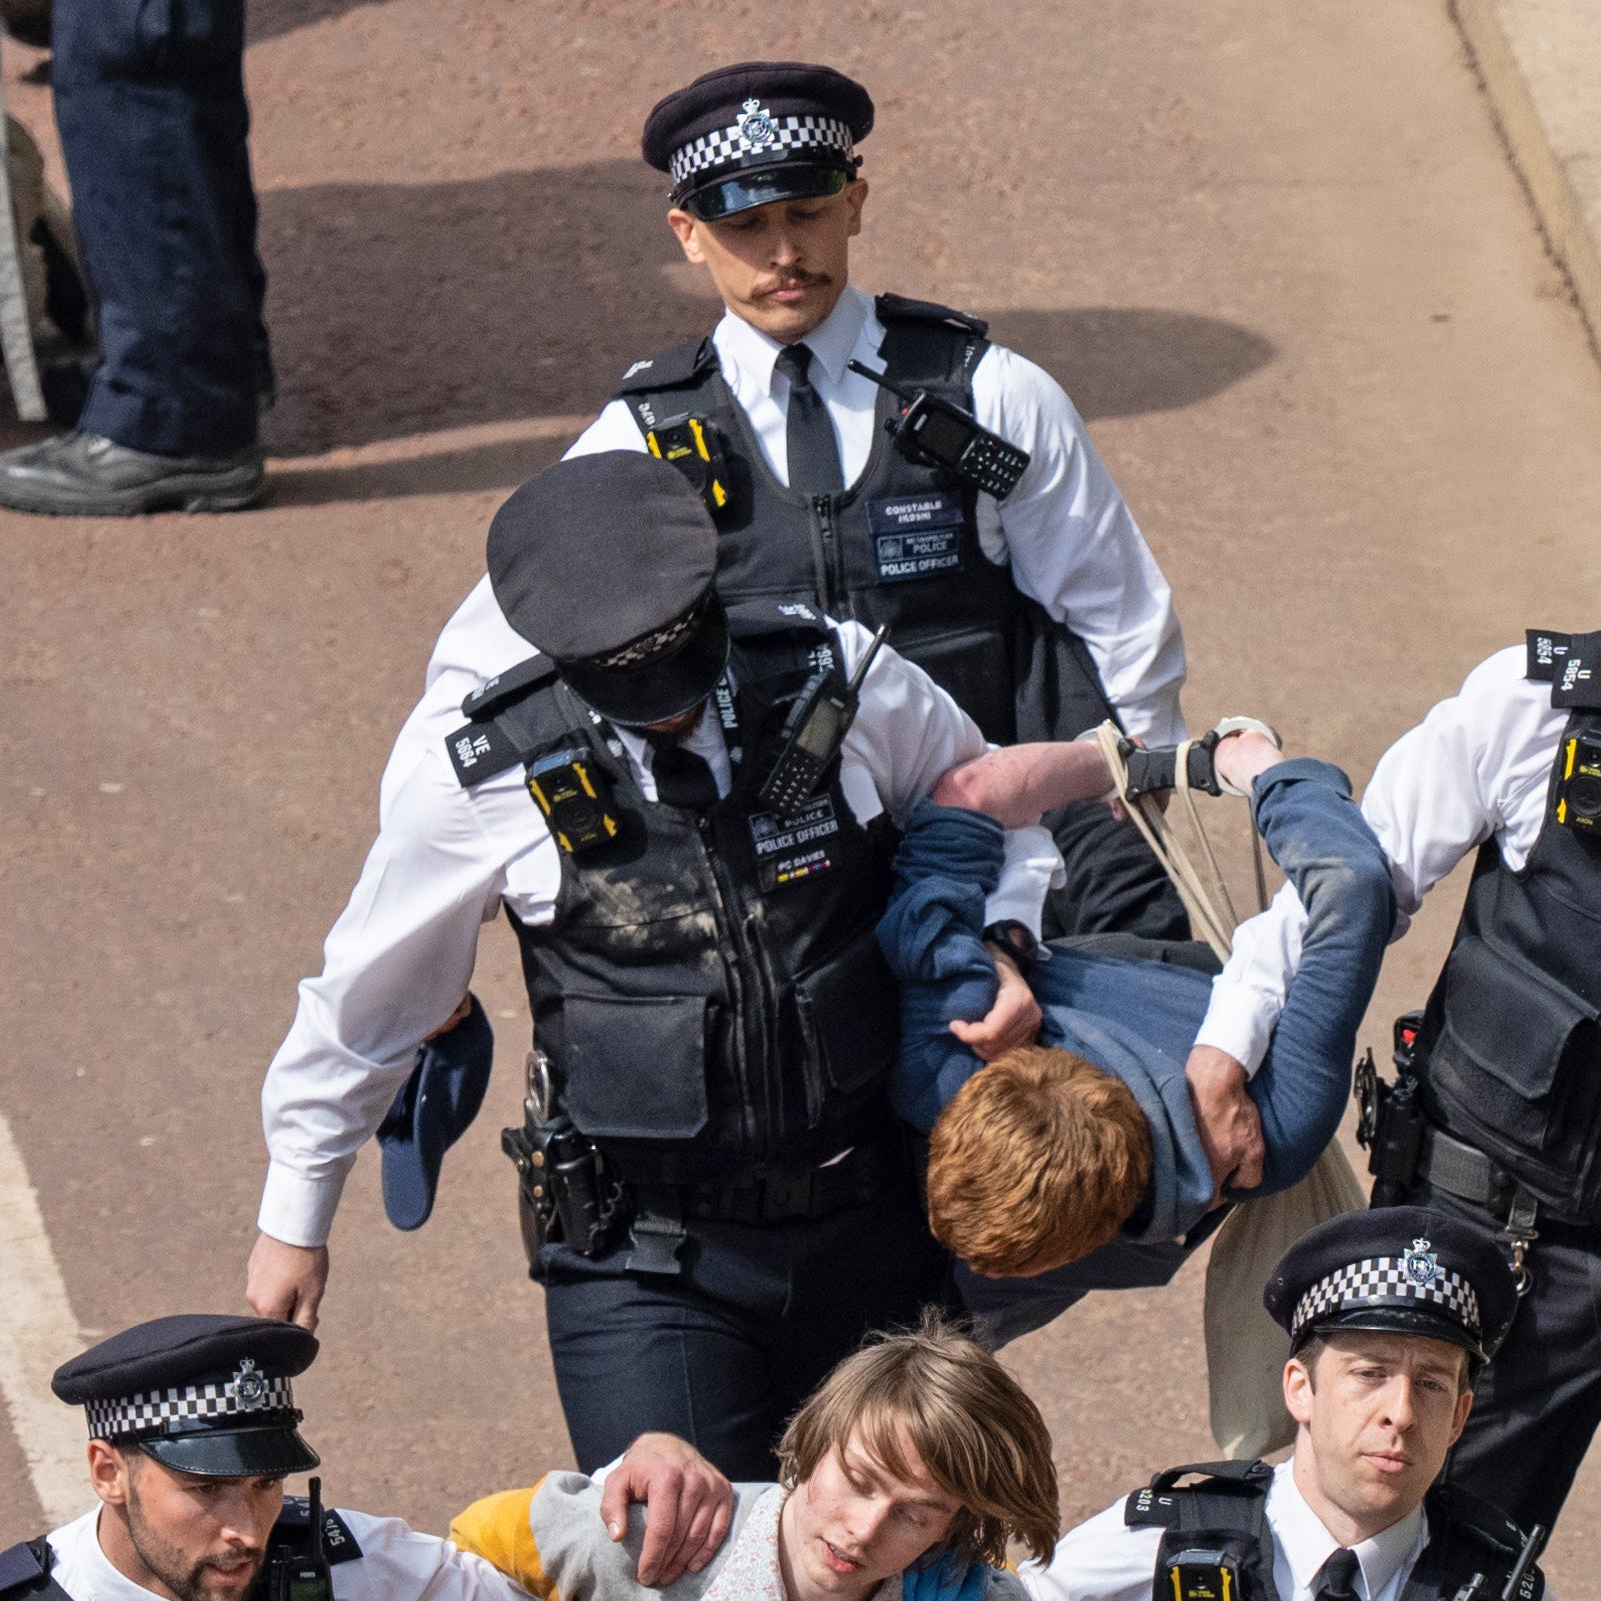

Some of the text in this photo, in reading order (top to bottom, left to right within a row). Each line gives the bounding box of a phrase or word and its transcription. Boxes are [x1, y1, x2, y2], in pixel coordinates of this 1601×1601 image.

[884, 500, 942, 516] CONSTABLE
[913, 541, 948, 554] POLICE
[880, 554, 959, 576] POLICE OFFICER
[1537, 636, 1553, 665] 5854
[1553, 646, 1569, 655] U
[1560, 658, 1582, 692] 5854
[1577, 669, 1592, 680] U
[715, 688, 739, 728] POLICE
[455, 736, 478, 768] 5664
[472, 734, 491, 756] VE
[755, 819, 839, 855] POLICE OFFICER
[1158, 1496, 1173, 1506] U
